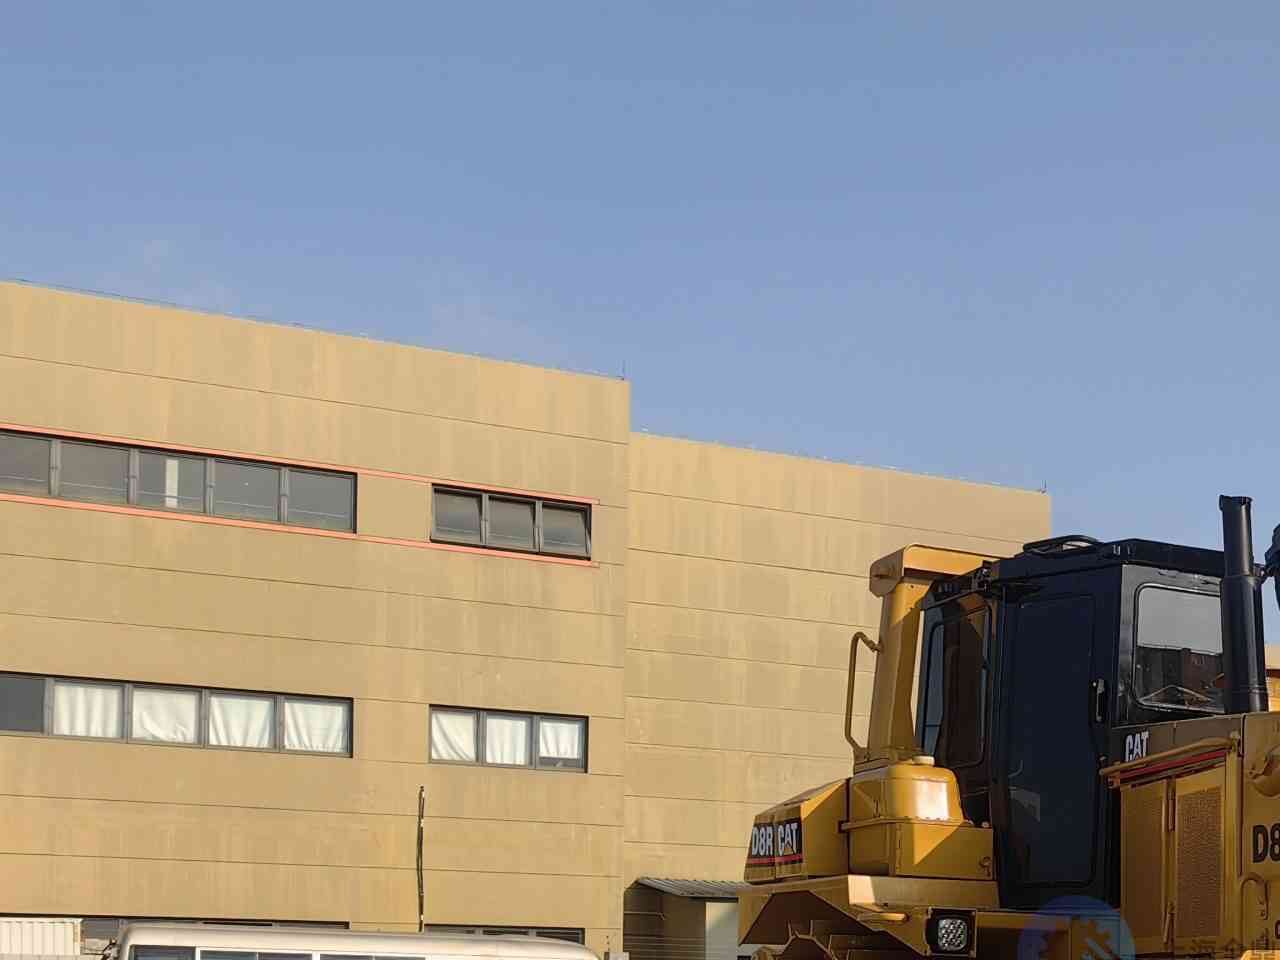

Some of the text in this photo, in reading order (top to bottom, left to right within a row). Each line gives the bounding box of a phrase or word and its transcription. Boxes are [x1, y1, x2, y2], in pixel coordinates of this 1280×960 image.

[1125, 731, 1149, 763] CAT
[752, 823, 798, 856] D8R CAT
